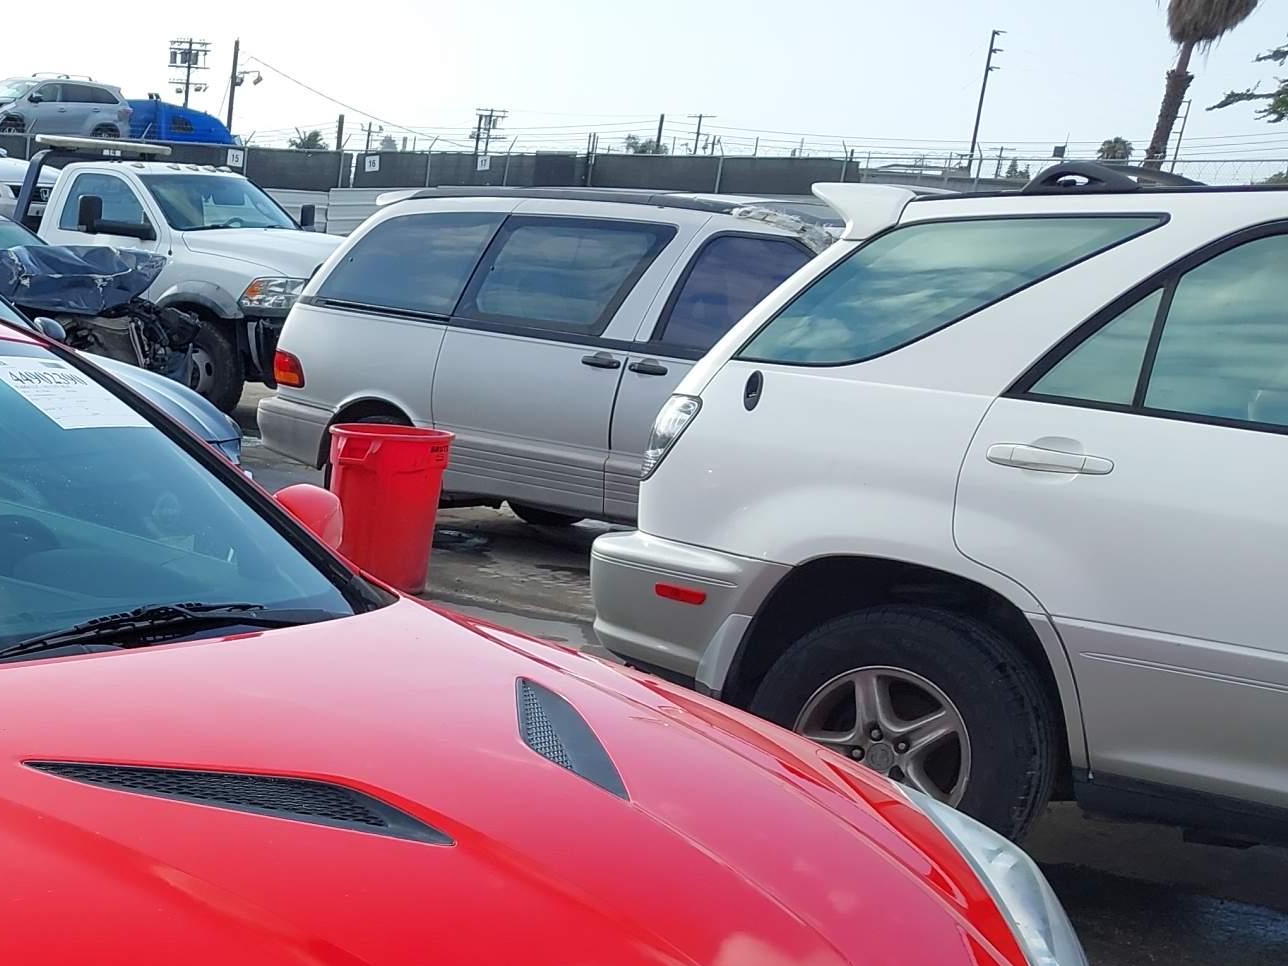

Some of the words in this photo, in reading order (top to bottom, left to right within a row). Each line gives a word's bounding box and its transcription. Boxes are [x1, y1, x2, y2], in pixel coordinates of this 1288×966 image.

[232, 153, 239, 163] 15
[368, 160, 376, 168] 16
[9, 370, 88, 386] 44902390
